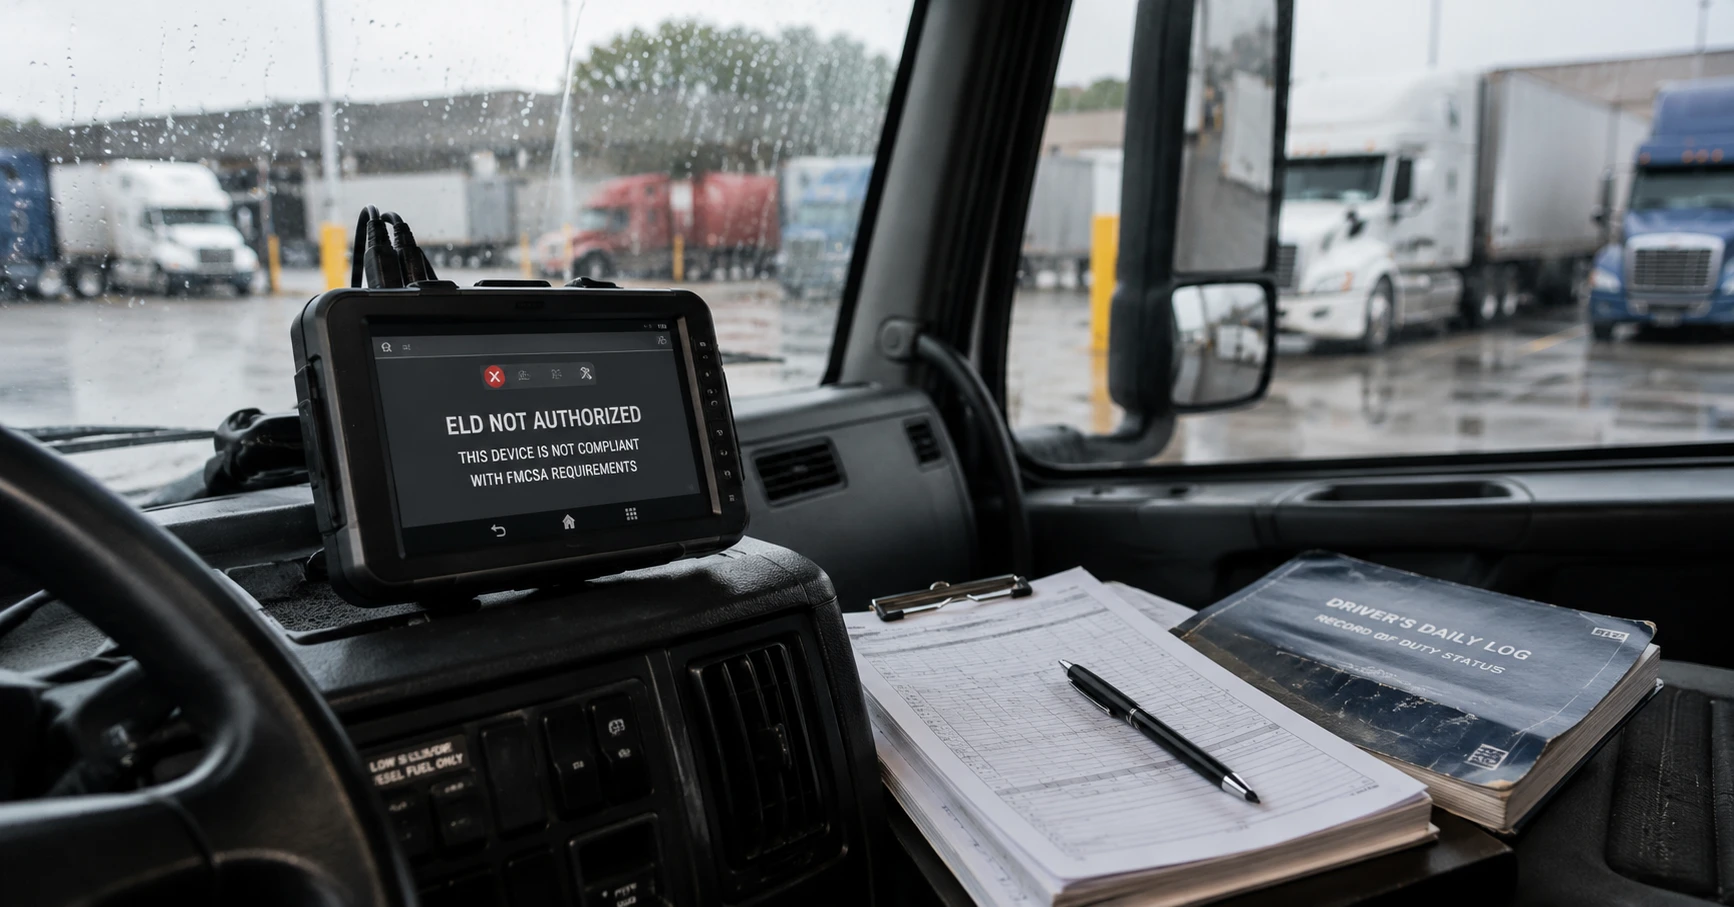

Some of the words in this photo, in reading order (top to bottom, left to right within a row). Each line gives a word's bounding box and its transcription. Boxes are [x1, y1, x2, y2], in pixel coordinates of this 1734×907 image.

[446, 415, 484, 436] ELD
[489, 412, 527, 433] NOT
[533, 405, 642, 430] AUTHORIZED
[458, 450, 488, 464] THIS
[491, 446, 535, 463] DEVICE
[537, 445, 549, 459] IS
[551, 443, 575, 457] NOT
[578, 438, 640, 455] COMPLIANT
[470, 472, 504, 487] WITH
[507, 467, 549, 484] FMCSA
[551, 460, 638, 480] REQUIREMENTS
[1325, 597, 1417, 629] DRIVER'S
[1417, 623, 1483, 646] DAILY
[1484, 641, 1532, 661] LOG
[1314, 614, 1372, 636] RECORD
[1399, 638, 1441, 655] DUTY
[1441, 652, 1506, 675] STATUS
[369, 756, 396, 773] LOW
[405, 761, 436, 778] FUEL
[435, 753, 464, 769] ONLY
